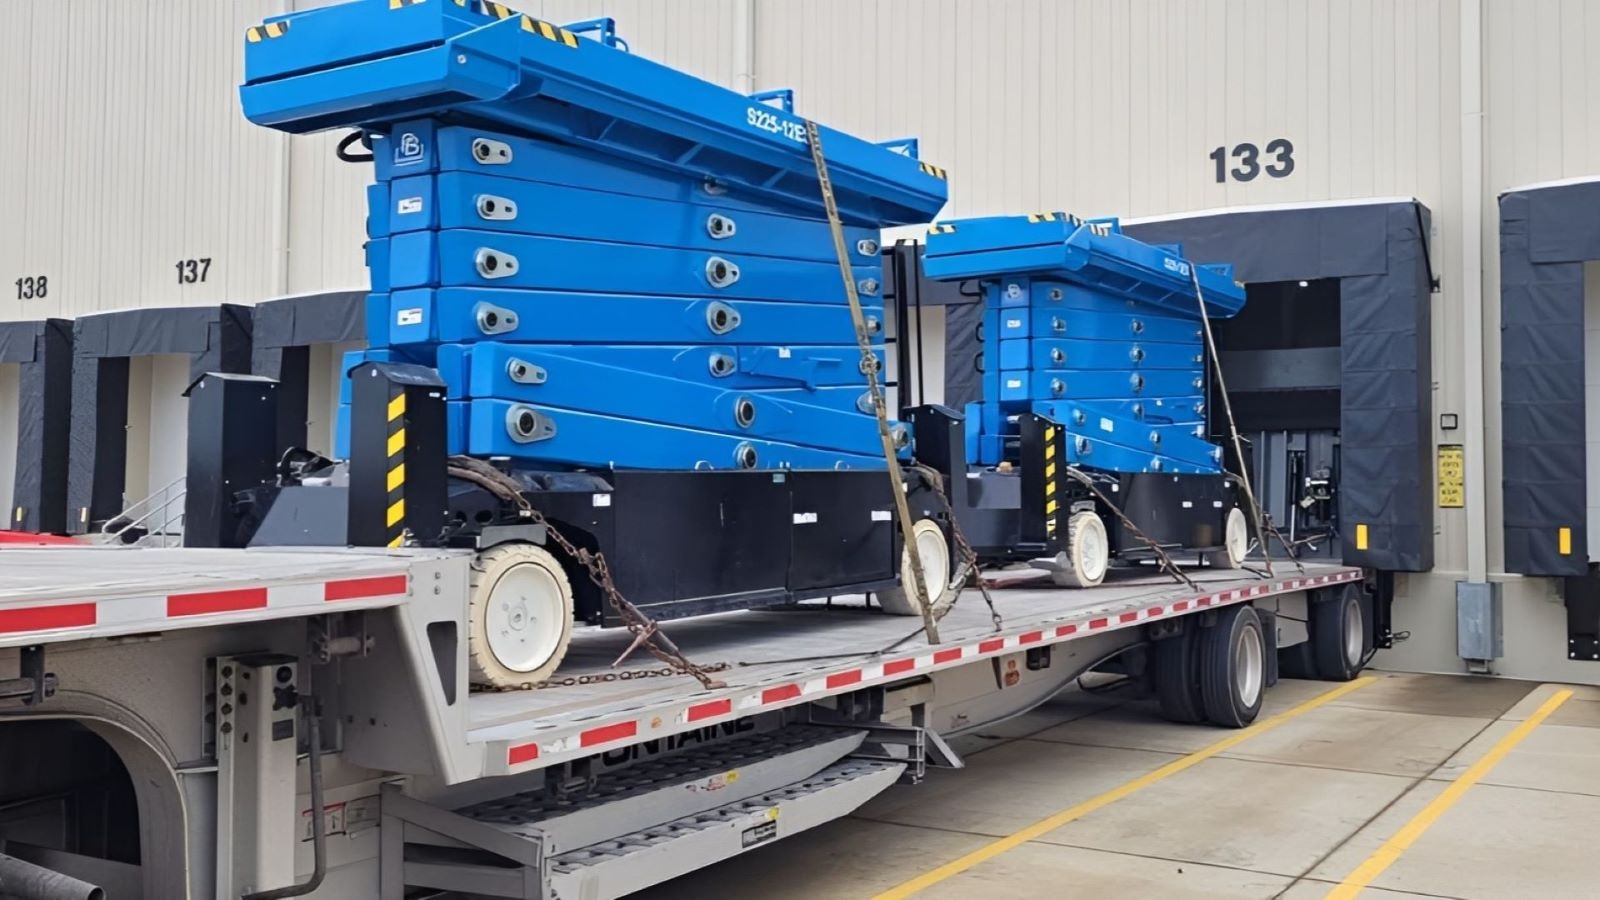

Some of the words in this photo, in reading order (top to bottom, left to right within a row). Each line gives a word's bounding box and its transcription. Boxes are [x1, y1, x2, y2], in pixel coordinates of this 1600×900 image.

[1209, 138, 1295, 183] 133
[175, 257, 212, 285] 137
[15, 275, 48, 300] 138
